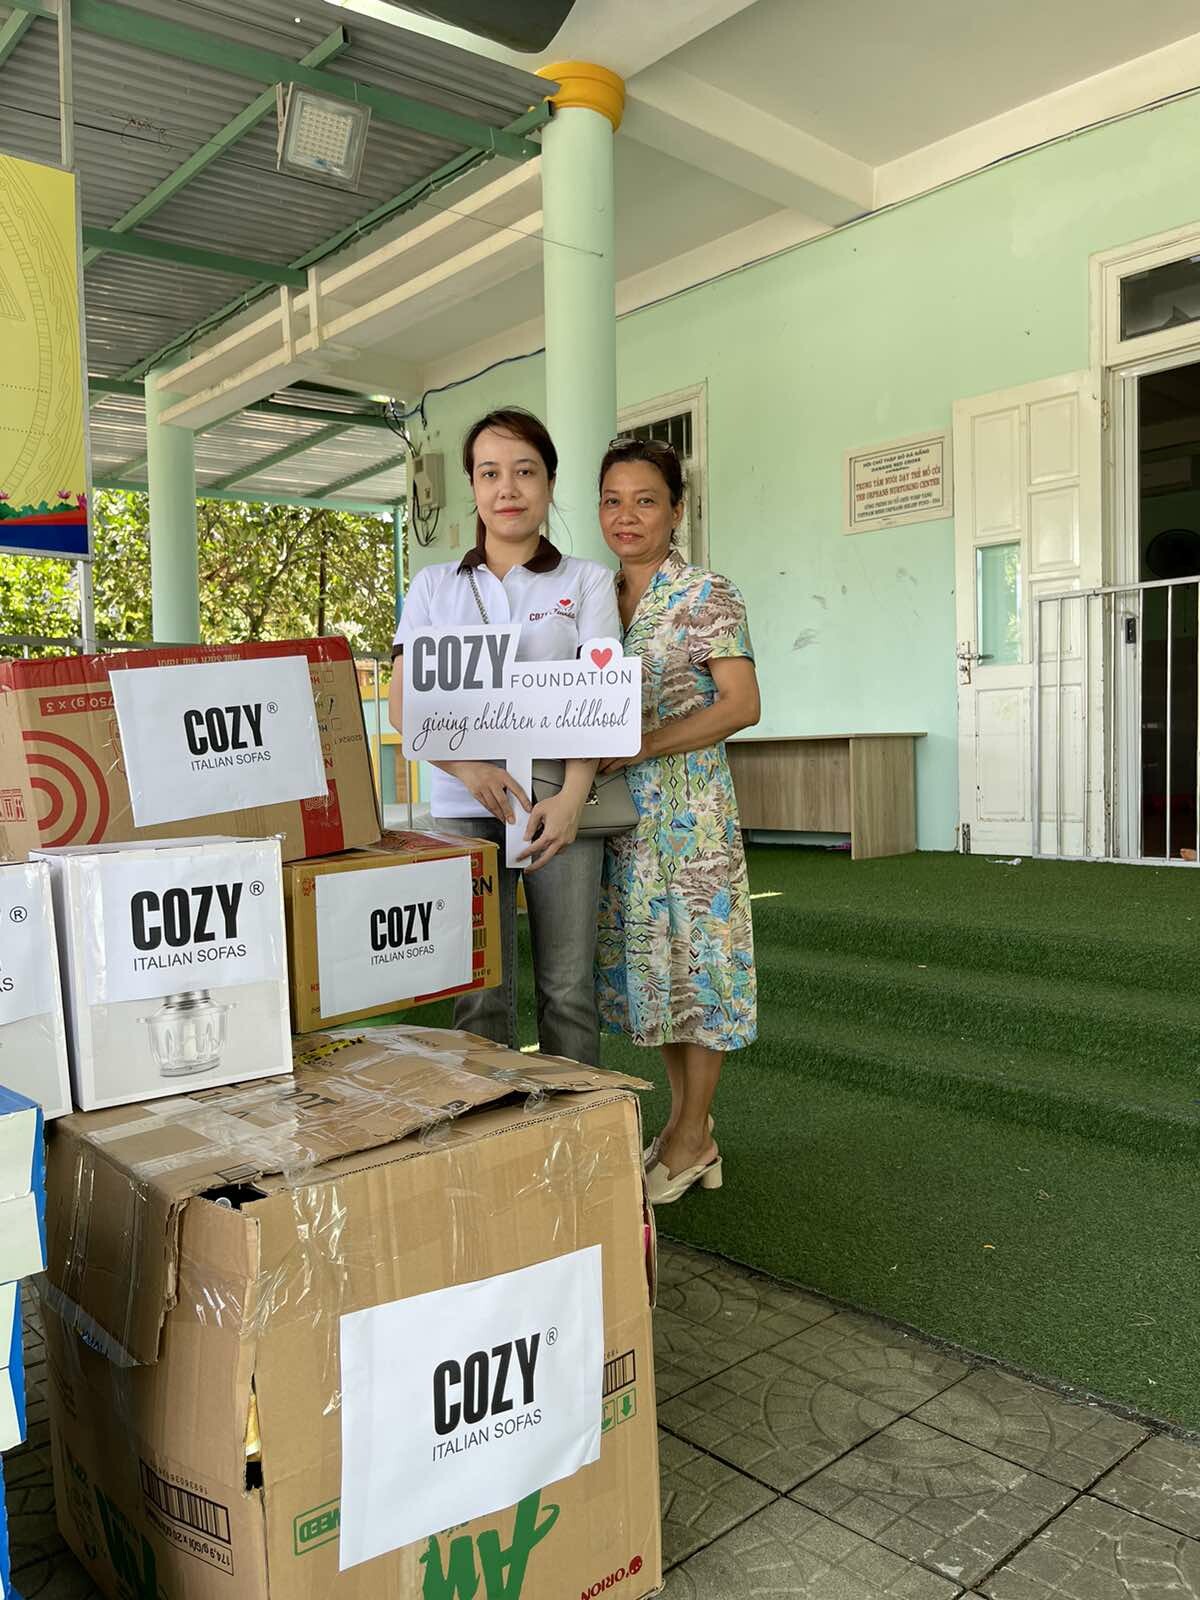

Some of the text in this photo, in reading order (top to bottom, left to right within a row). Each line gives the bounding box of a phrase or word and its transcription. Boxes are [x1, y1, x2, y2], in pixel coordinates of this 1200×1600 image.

[856, 492, 865, 502] THE
[866, 488, 889, 500] ORPHANS
[889, 481, 919, 495] NURTURING
[919, 477, 940, 489] CENTER
[412, 634, 632, 692] COZY FOUNDATION
[46, 701, 55, 713] 3
[183, 704, 263, 756] COZY
[412, 697, 630, 752] giving children a childhood
[190, 751, 272, 771] ITALIAN SOFAS
[130, 882, 243, 951] COZY
[370, 900, 433, 952] COZY
[133, 944, 247, 971] ITALIAN SOFAS
[370, 944, 435, 966] ITALIAN SOFAS
[433, 1332, 541, 1436] COZY
[432, 1408, 542, 1462] ITALIAN SOFAS
[580, 1567, 628, 1600] ORION
